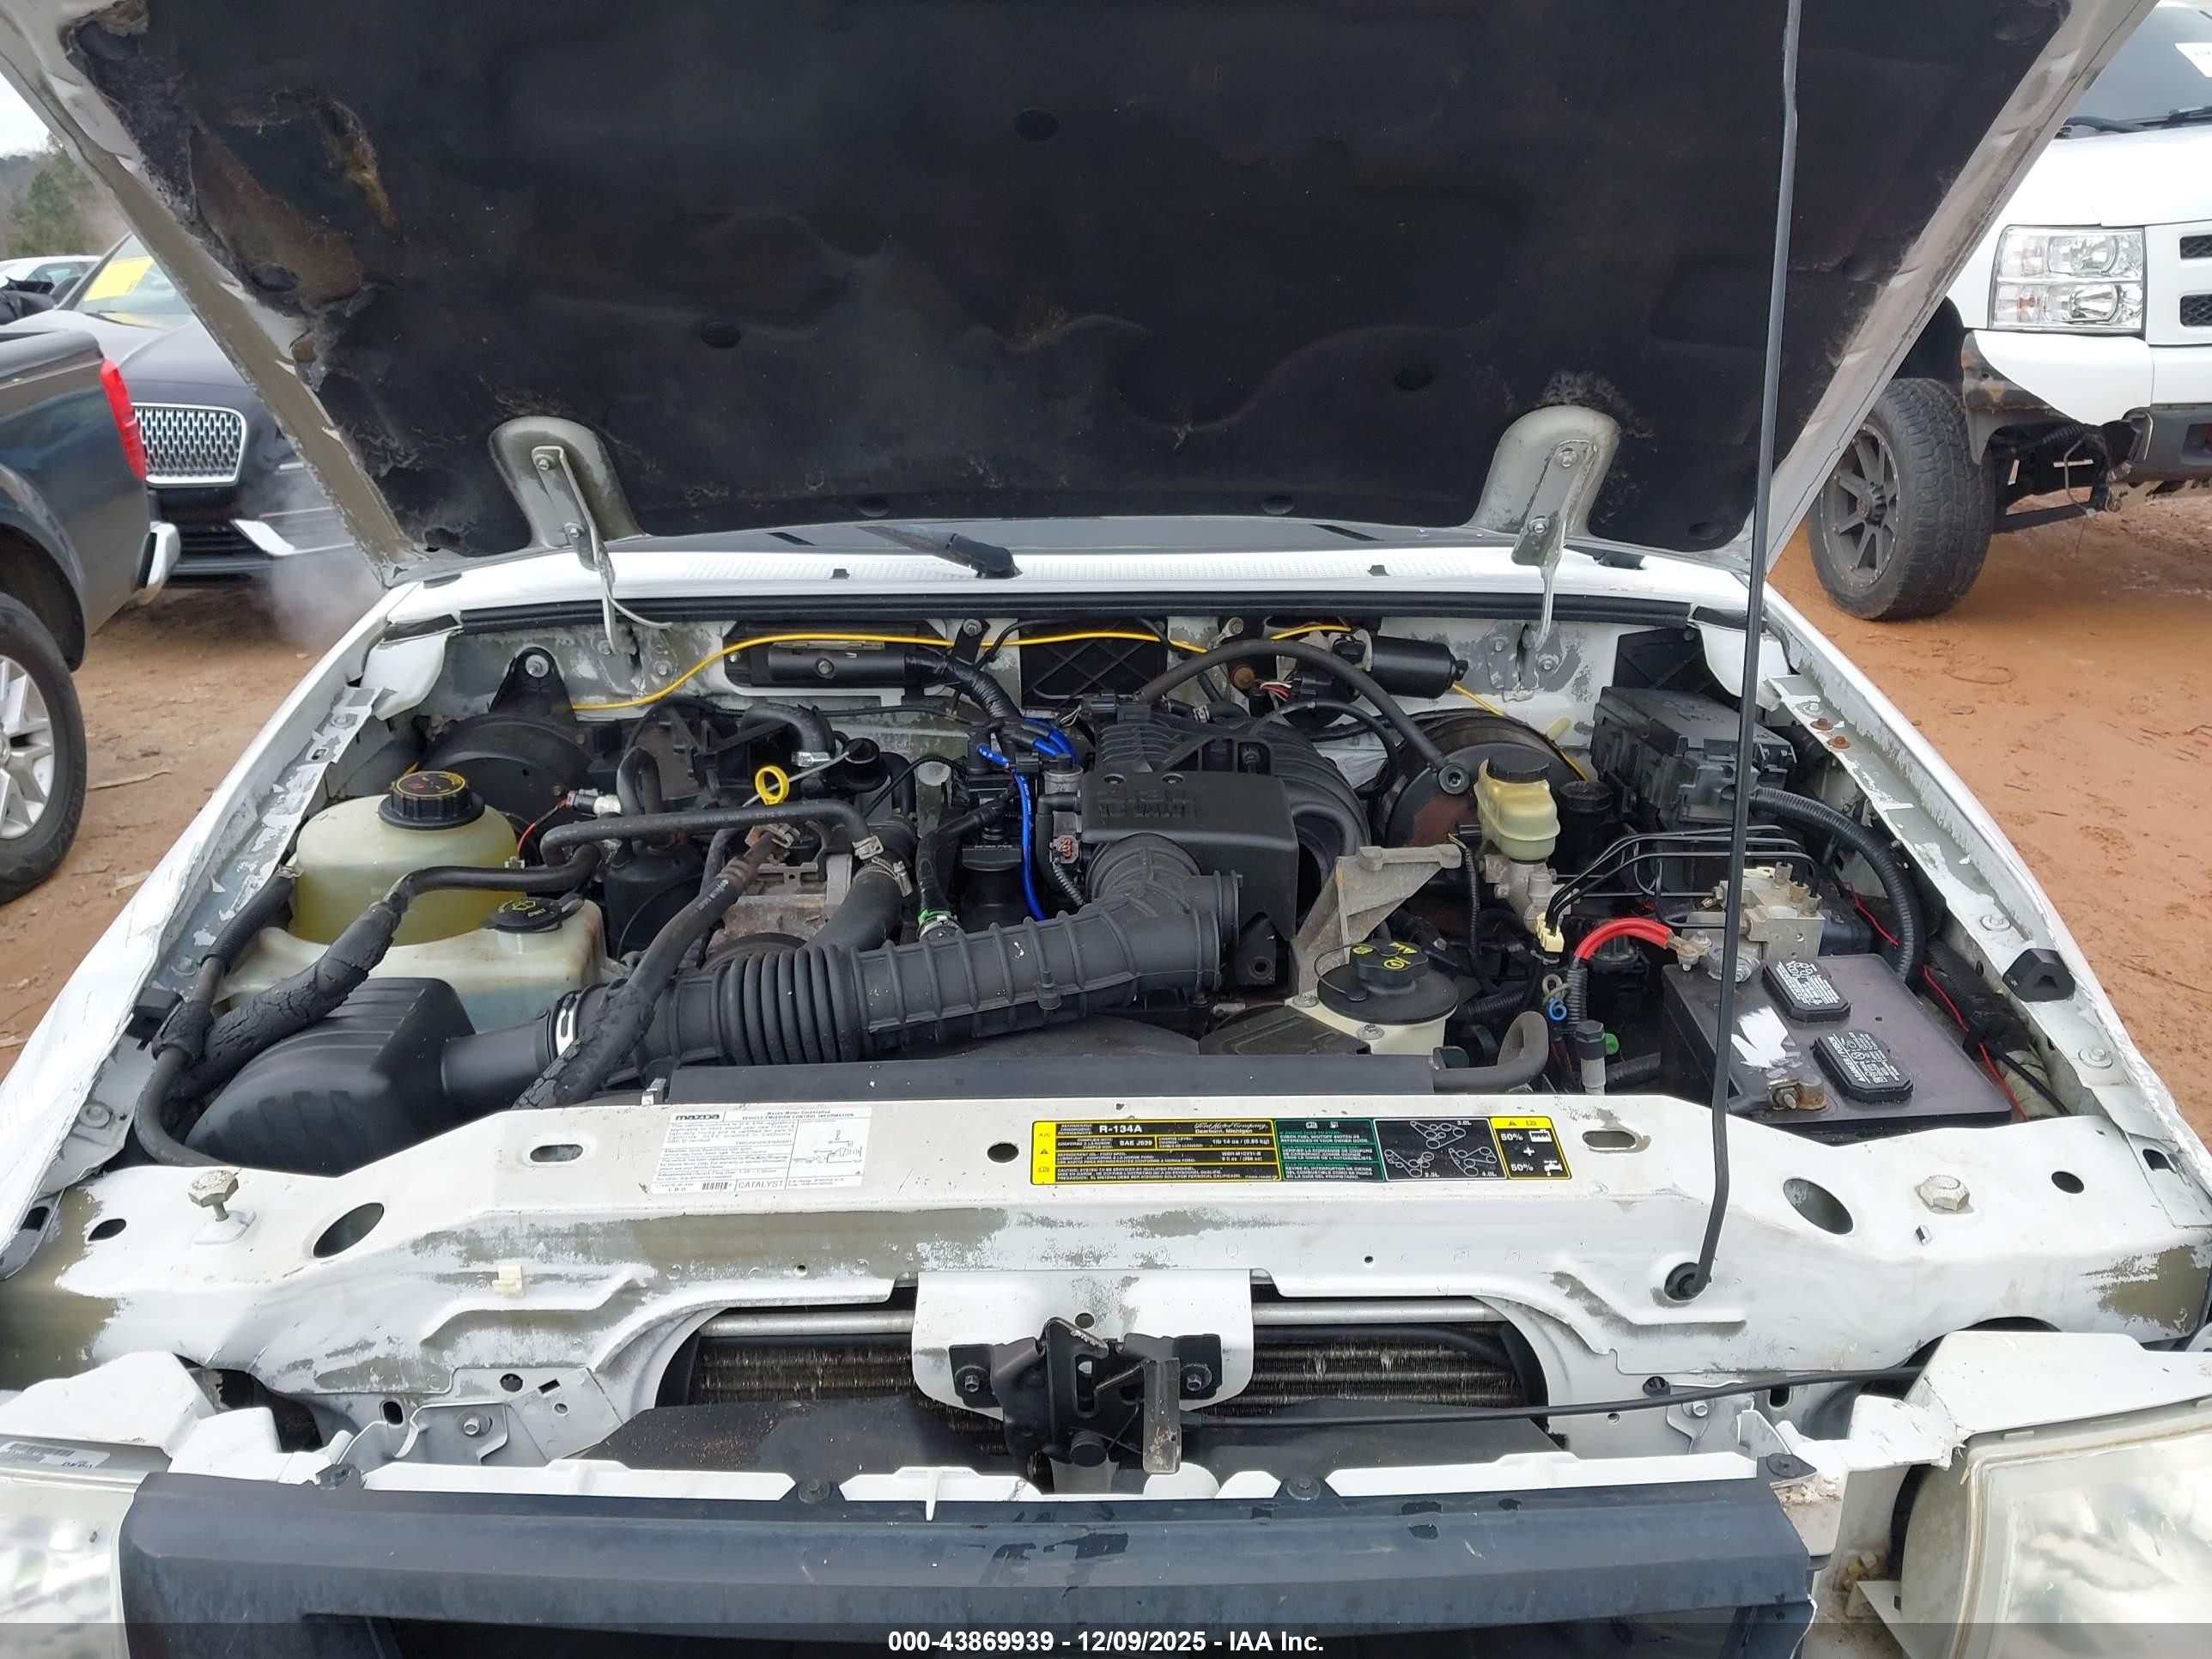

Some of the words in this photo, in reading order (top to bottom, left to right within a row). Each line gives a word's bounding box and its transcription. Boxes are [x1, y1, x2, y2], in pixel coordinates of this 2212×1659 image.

[1099, 1124, 1142, 1133] R-134A
[1500, 1133, 1523, 1141] 50%
[1510, 1163, 1534, 1172] 50%
[738, 1180, 784, 1189] CATALYST
